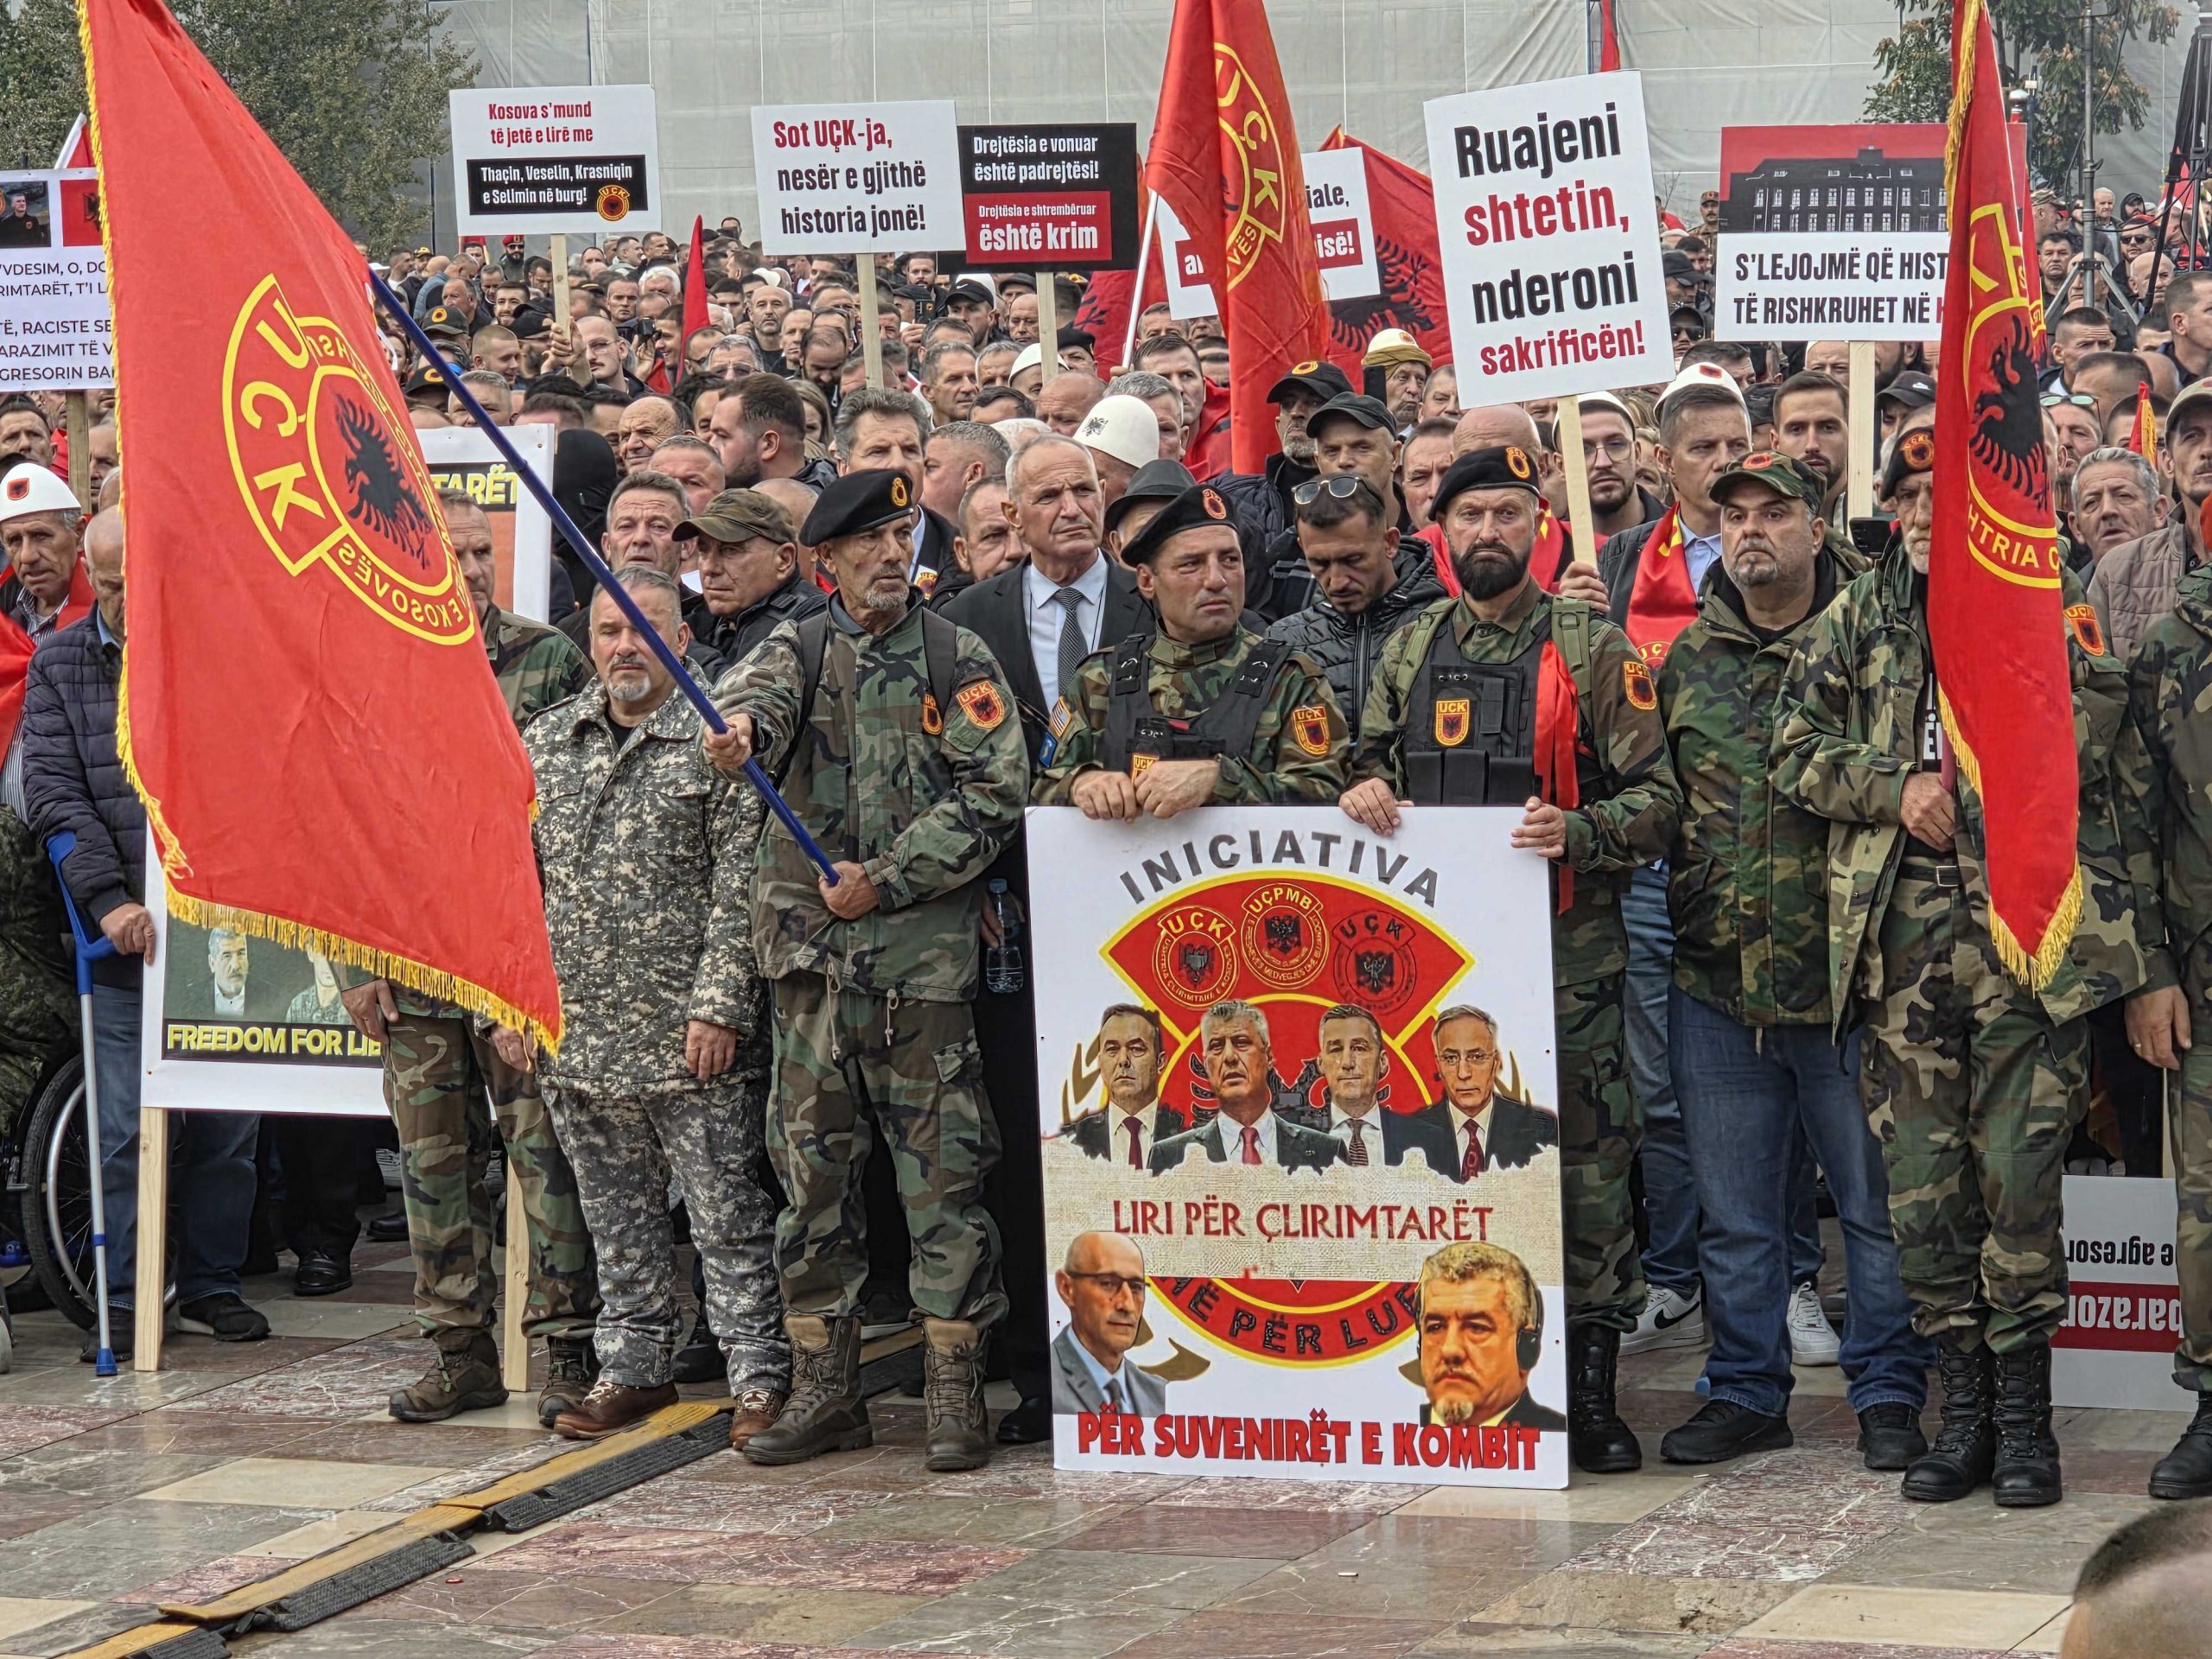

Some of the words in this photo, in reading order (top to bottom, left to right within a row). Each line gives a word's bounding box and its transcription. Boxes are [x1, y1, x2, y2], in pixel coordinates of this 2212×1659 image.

[489, 104, 537, 119] Kosova
[541, 101, 592, 118] s'mund
[491, 129, 504, 144] të
[506, 128, 532, 147] jetë
[536, 131, 543, 143] e
[546, 127, 569, 143] lirë
[573, 128, 593, 143] me
[773, 121, 810, 148] Sot
[815, 118, 892, 152] UÇK-ja,
[973, 136, 1037, 157] Drejtësia
[1039, 138, 1048, 152] e
[1050, 137, 1098, 152] vonuar
[1454, 102, 1620, 179] Ruajeni
[481, 165, 523, 184] Thaçin,
[525, 164, 573, 181] Veselin,
[575, 163, 632, 181] Krasniqin
[778, 163, 840, 191] nesër
[845, 167, 858, 189] e
[863, 161, 926, 194] gjithë
[975, 162, 1016, 181] është
[1020, 161, 1099, 183] padrejtësi!
[483, 193, 490, 205] e
[493, 188, 537, 204] Selimin
[539, 188, 554, 202] në
[556, 188, 587, 205] burg!
[781, 205, 867, 233] historia
[871, 204, 926, 238] jonë!
[979, 205, 1022, 219] Drejtësia
[1024, 207, 1030, 216] e
[1032, 204, 1096, 216] shtrembëruar
[1465, 179, 1630, 246] shtetin,
[979, 223, 1042, 251] është
[1047, 221, 1098, 250] krim
[1314, 231, 1355, 258] isë!
[68, 262, 82, 276] O,
[1736, 247, 1859, 281] S'LEJOJMË
[1866, 247, 1893, 283] QË
[1901, 252, 1949, 280] HIST
[75, 283, 92, 295] T'I
[1472, 251, 1639, 325] nderoni
[1733, 293, 1758, 325] TË
[1764, 296, 1897, 324] RISHKRUHET
[1903, 292, 1929, 324] NË
[22, 321, 90, 334] RACISTE
[0, 344, 75, 358] ARAZIMIT
[79, 340, 99, 356] TË
[1480, 320, 1645, 376] sakrificën!
[1439, 702, 1466, 713] UCK
[1120, 830, 1440, 909] INICIATIVA
[1249, 887, 1313, 913] UÇPMB
[1166, 912, 1226, 939] UÇK
[167, 1024, 287, 1054] FREEDOM
[291, 1028, 343, 1056] FOR
[1113, 1199, 1173, 1236] LIRI
[1185, 1195, 1244, 1237] PËR
[1255, 1198, 1494, 1243] ÇLIRIMTARËT
[1229, 1307, 1323, 1355] PËR
[1078, 1402, 1145, 1456] PËR
[1154, 1408, 1352, 1467] SUVENIRËT
[1361, 1416, 1384, 1465] E
